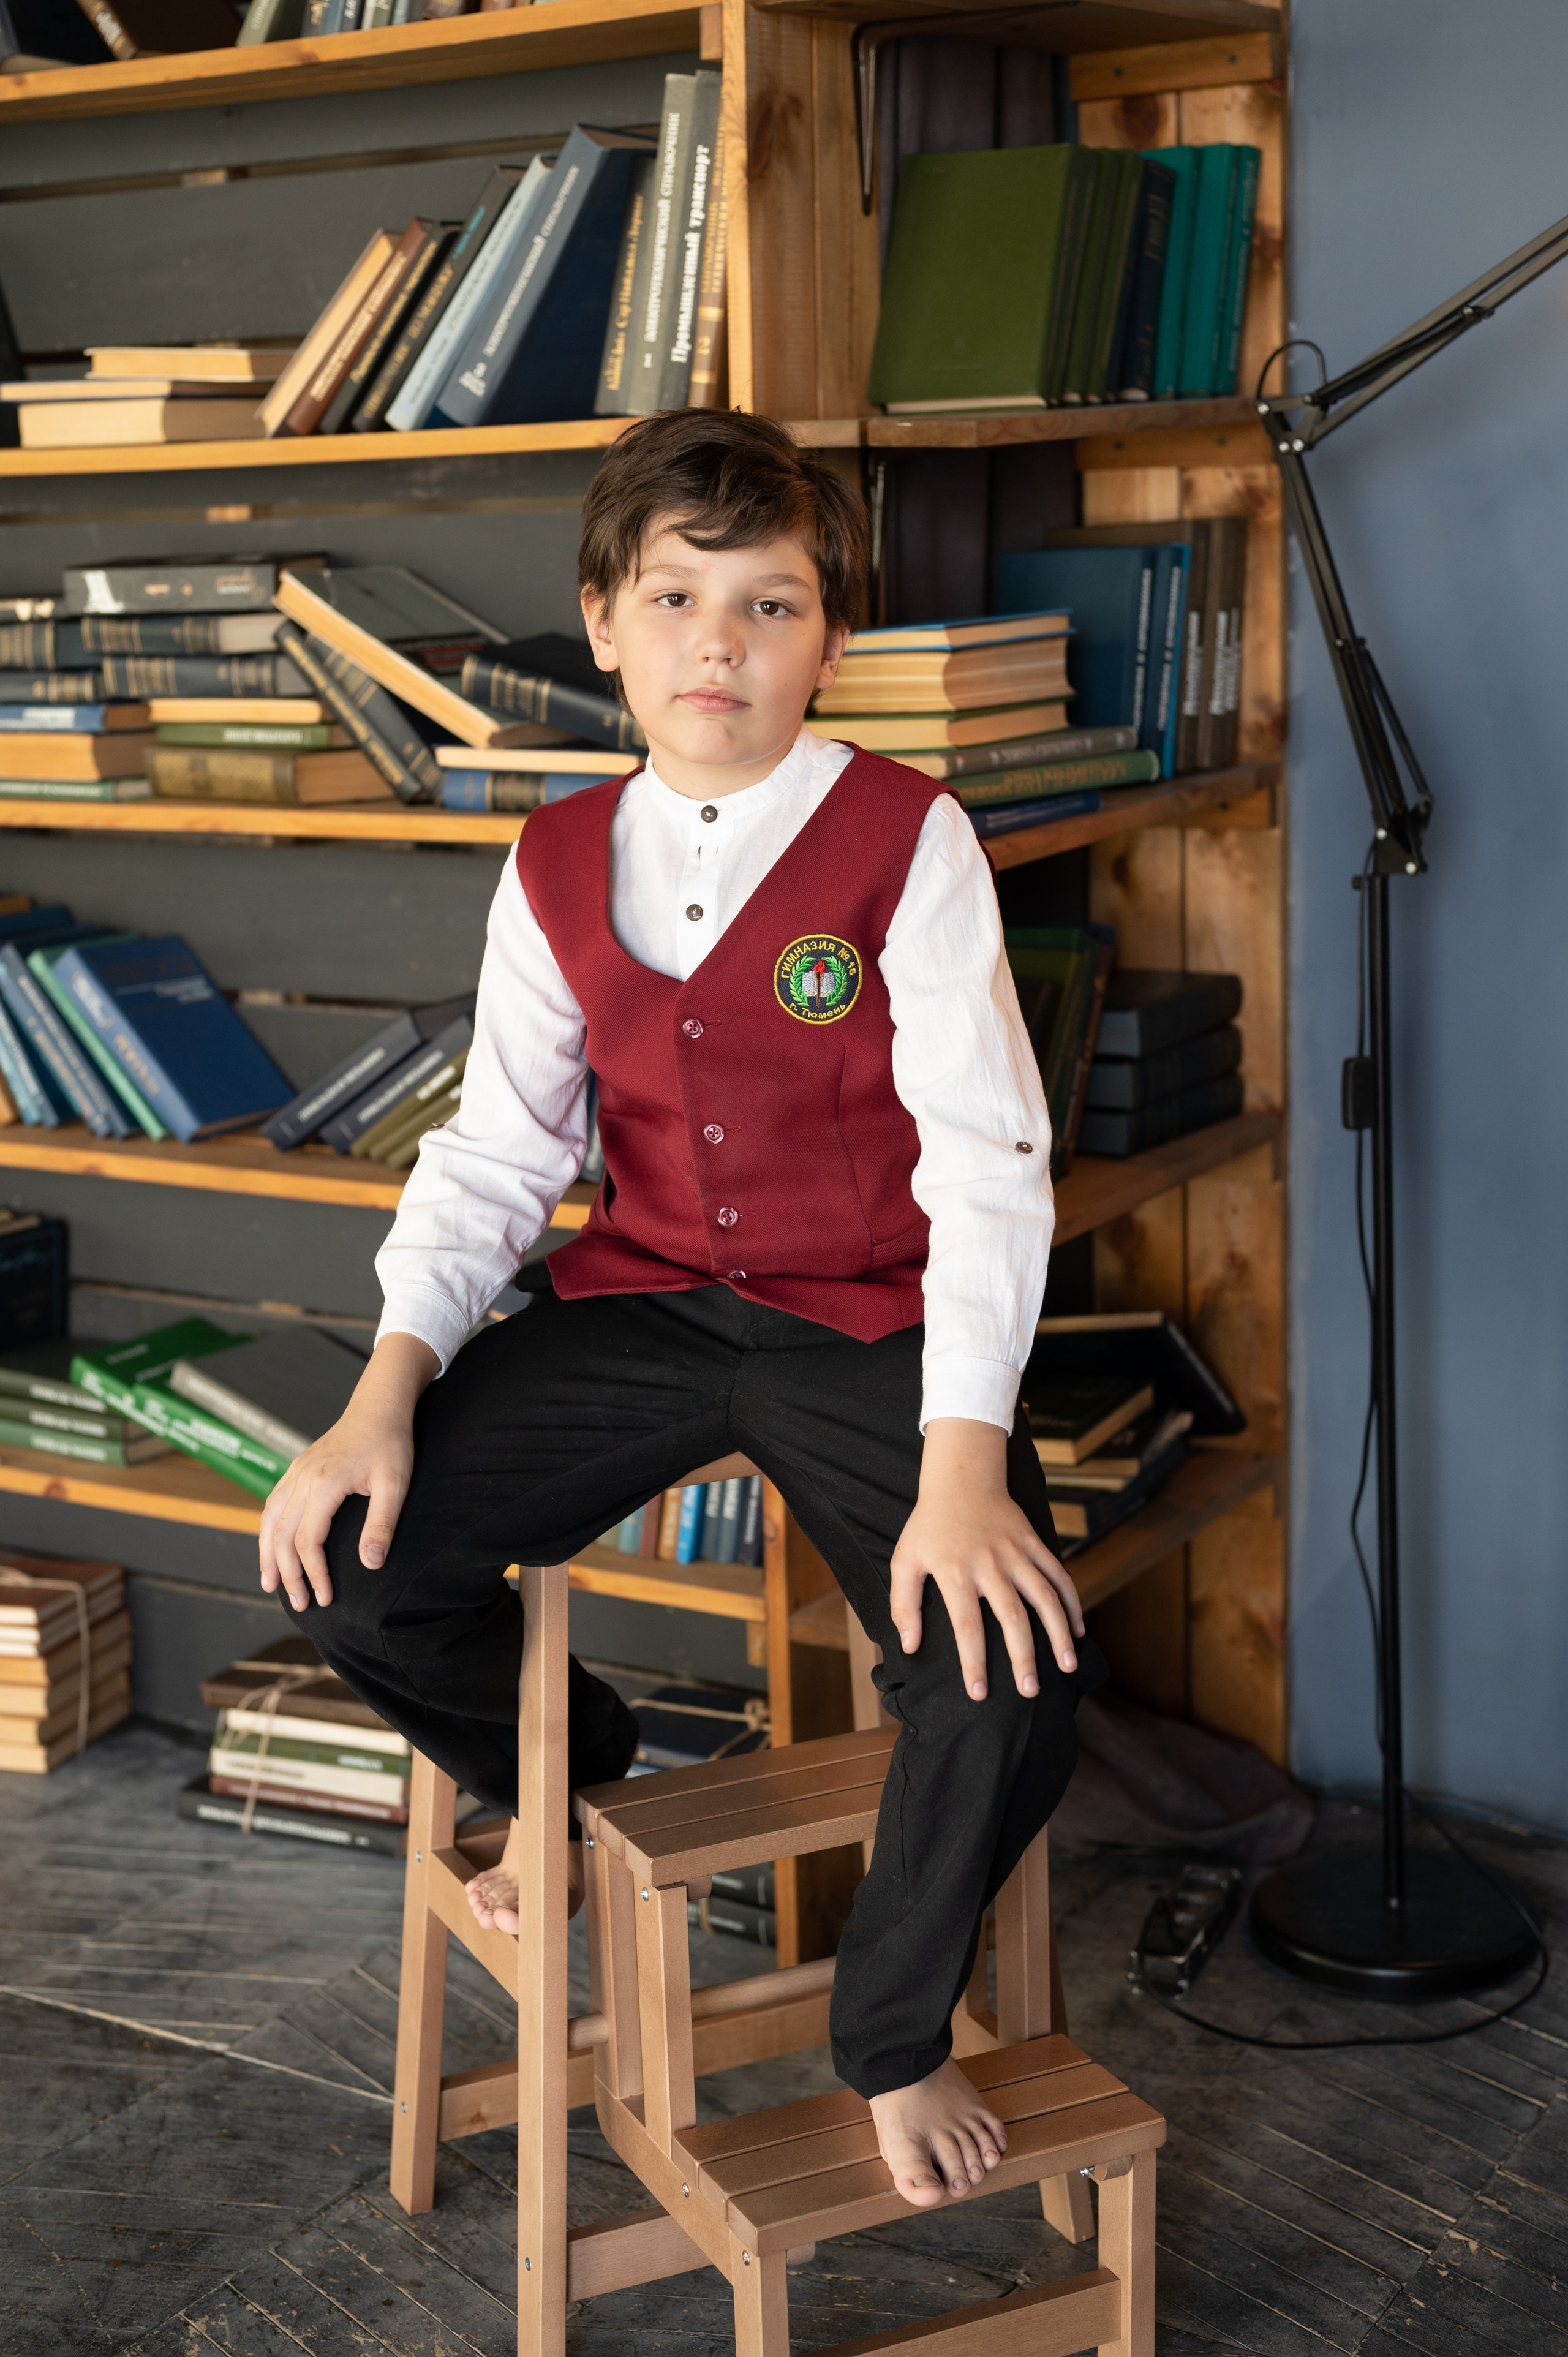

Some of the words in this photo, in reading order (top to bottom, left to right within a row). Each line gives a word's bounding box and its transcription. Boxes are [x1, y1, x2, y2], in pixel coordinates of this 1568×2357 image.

[644, 198, 671, 342] ЭЛЕКТРОТЕХНИЧЕСКИЙ
[660, 112, 680, 197] СПРАВОЧНИК
[671, 231, 701, 363] Промышленный
[688, 144, 711, 228] транспорт
[697, 336, 710, 355] 2
[781, 941, 835, 978] ГИМНАЗИЯ
[837, 948, 850, 962] №
[848, 962, 856, 976] 16
[802, 1005, 846, 1019] Тюмень
